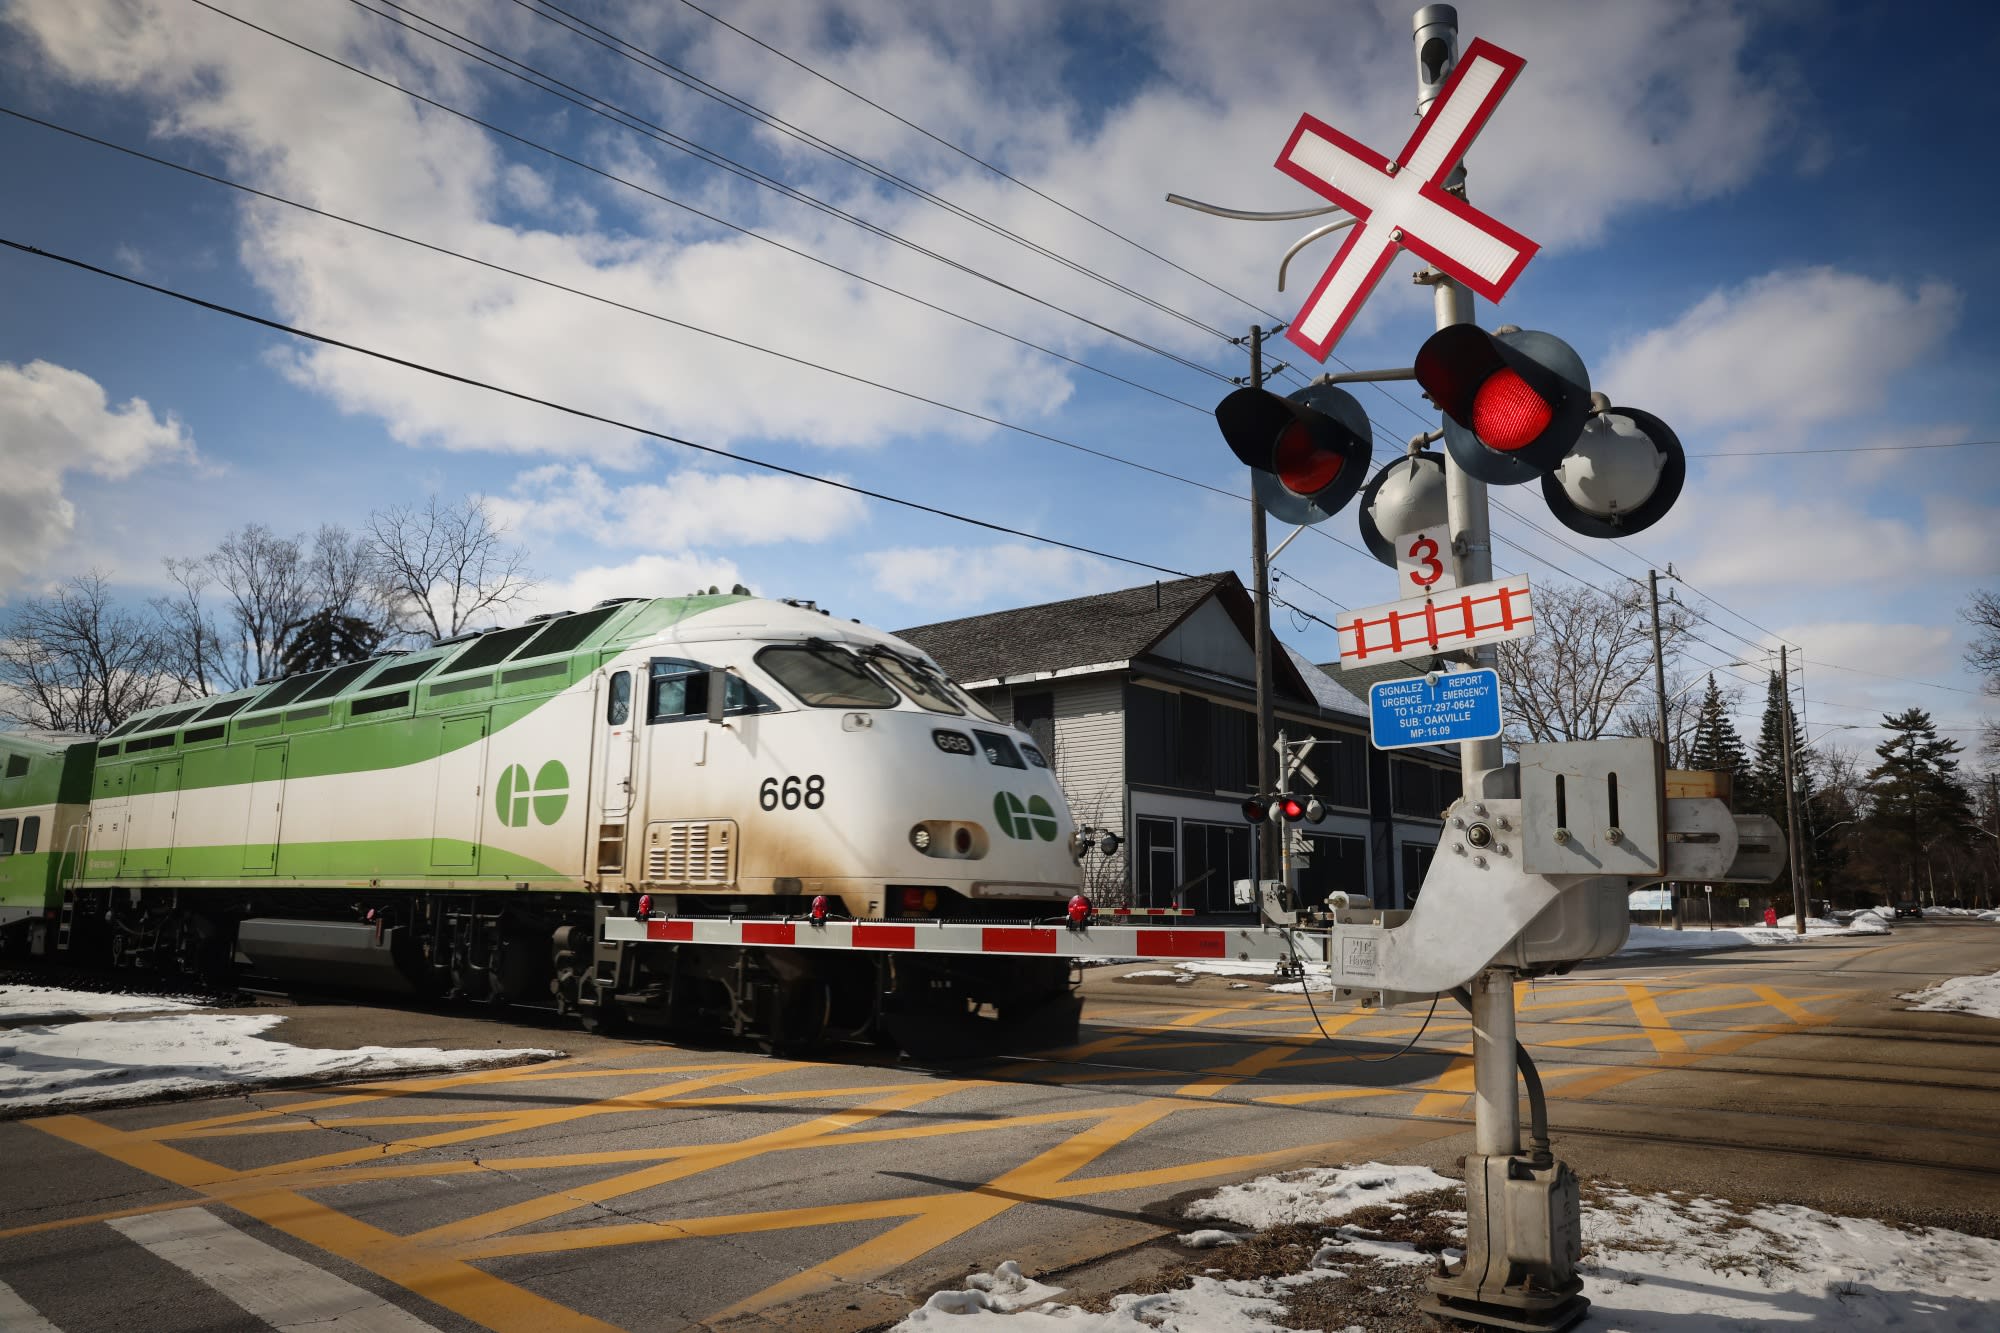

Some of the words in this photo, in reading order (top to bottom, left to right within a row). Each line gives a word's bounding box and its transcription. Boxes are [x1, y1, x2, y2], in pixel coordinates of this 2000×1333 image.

[1409, 538, 1444, 586] 3
[1449, 675, 1483, 688] REPORT
[1379, 683, 1423, 697] SIGNALEZ
[1442, 687, 1489, 700] EMERGENCY
[1382, 695, 1422, 707] URGENCE
[1394, 708, 1407, 717] TO
[1410, 701, 1475, 714] 1-877-297-0642
[1400, 718, 1422, 728] SUB:
[1424, 712, 1471, 725] OAKVILLE
[1410, 726, 1450, 738] MP:16.09
[937, 735, 971, 752] 668
[759, 774, 825, 812] 668
